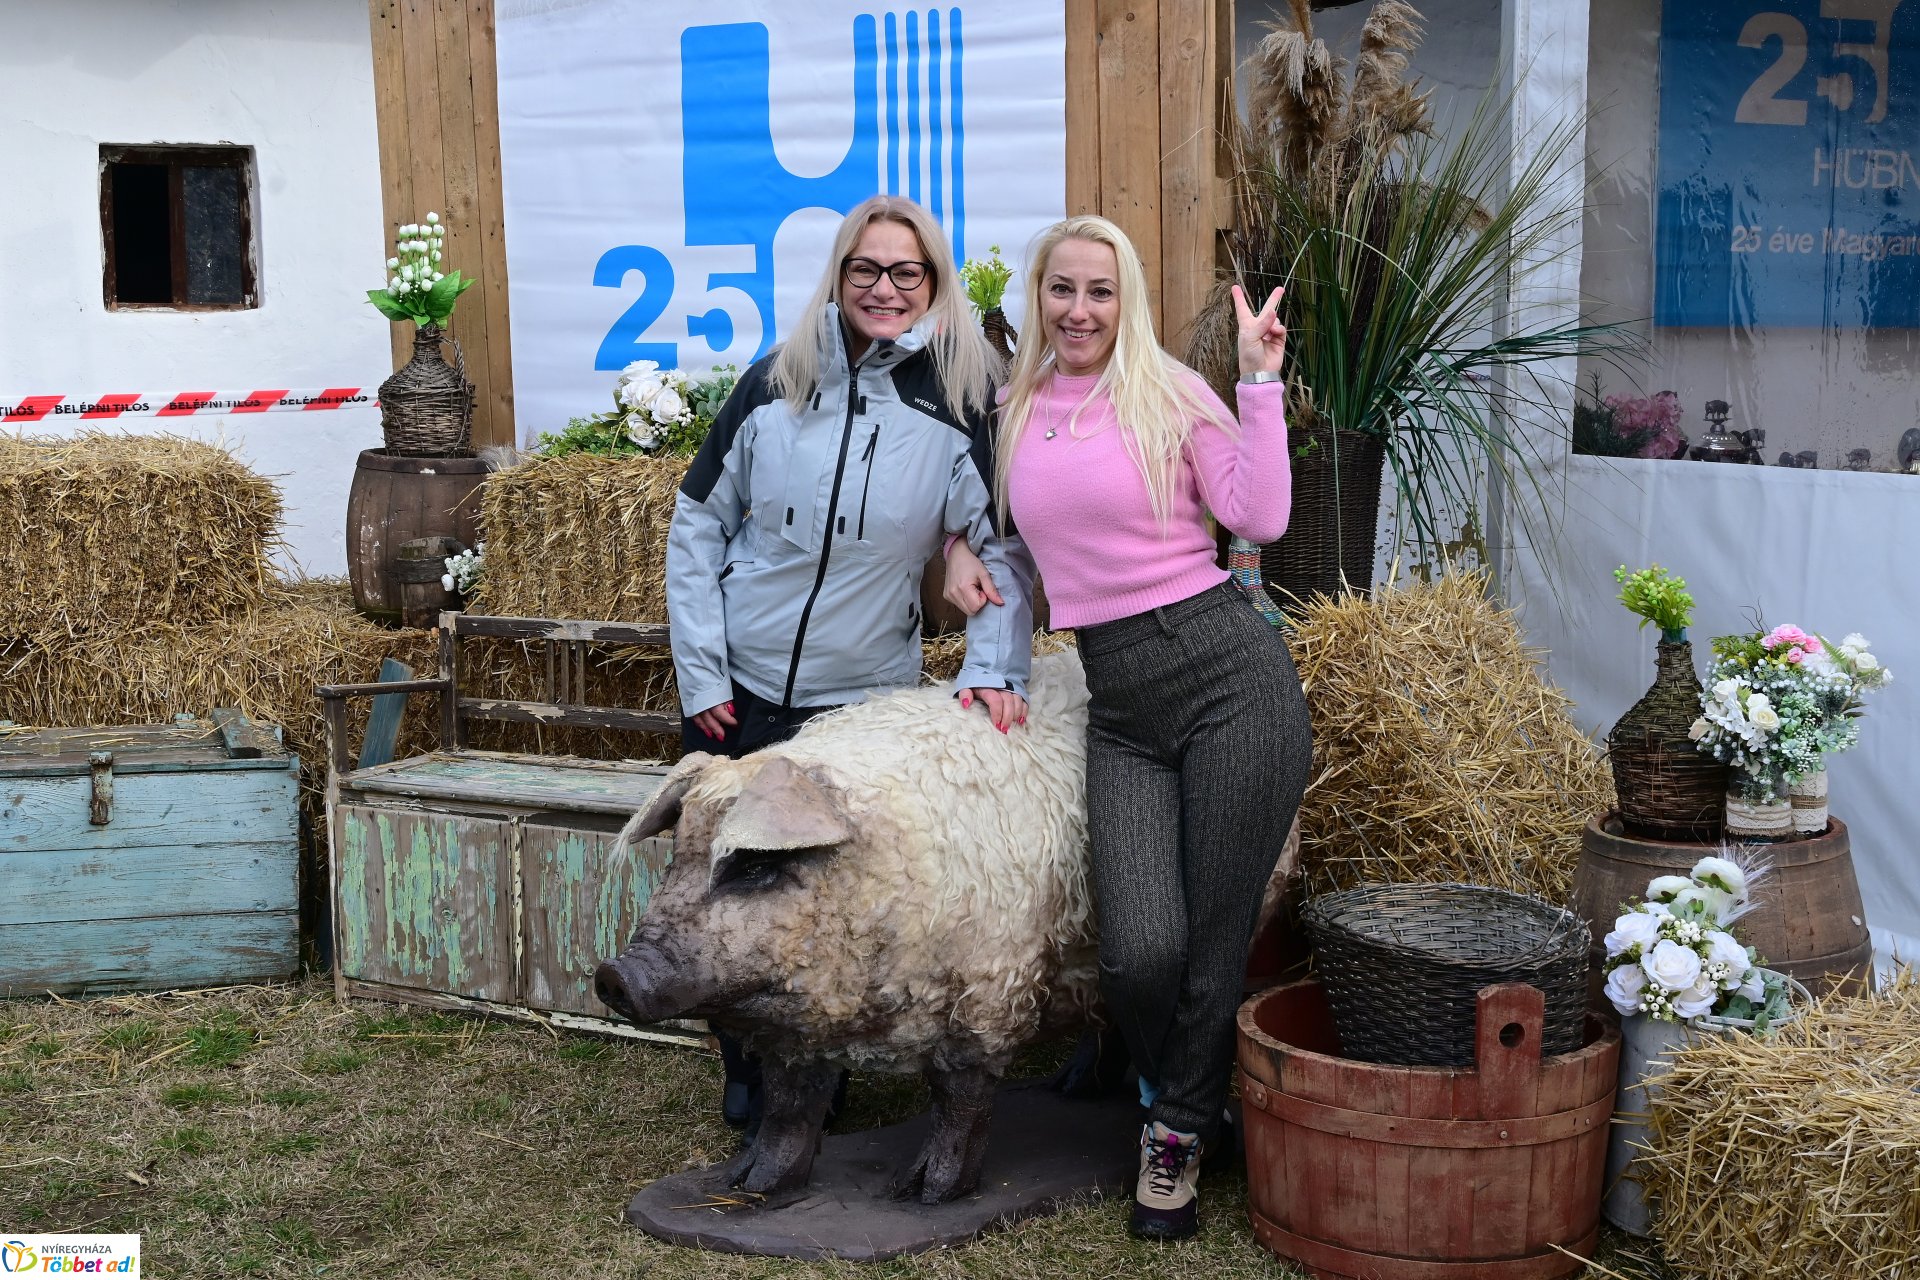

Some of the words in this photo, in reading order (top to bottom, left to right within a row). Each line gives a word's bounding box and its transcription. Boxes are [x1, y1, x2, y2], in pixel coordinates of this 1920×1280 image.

[1734, 11, 1877, 126] 25
[1731, 224, 1763, 253] 25
[1768, 225, 1815, 254] éve
[1821, 227, 1920, 262] Magyar
[592, 244, 765, 372] 25
[54, 402, 110, 415] BELÉPNI
[112, 402, 150, 412] TILOS
[169, 399, 223, 410] BELÉPNI
[224, 400, 261, 408] TILOS
[914, 397, 938, 412] WEDZE
